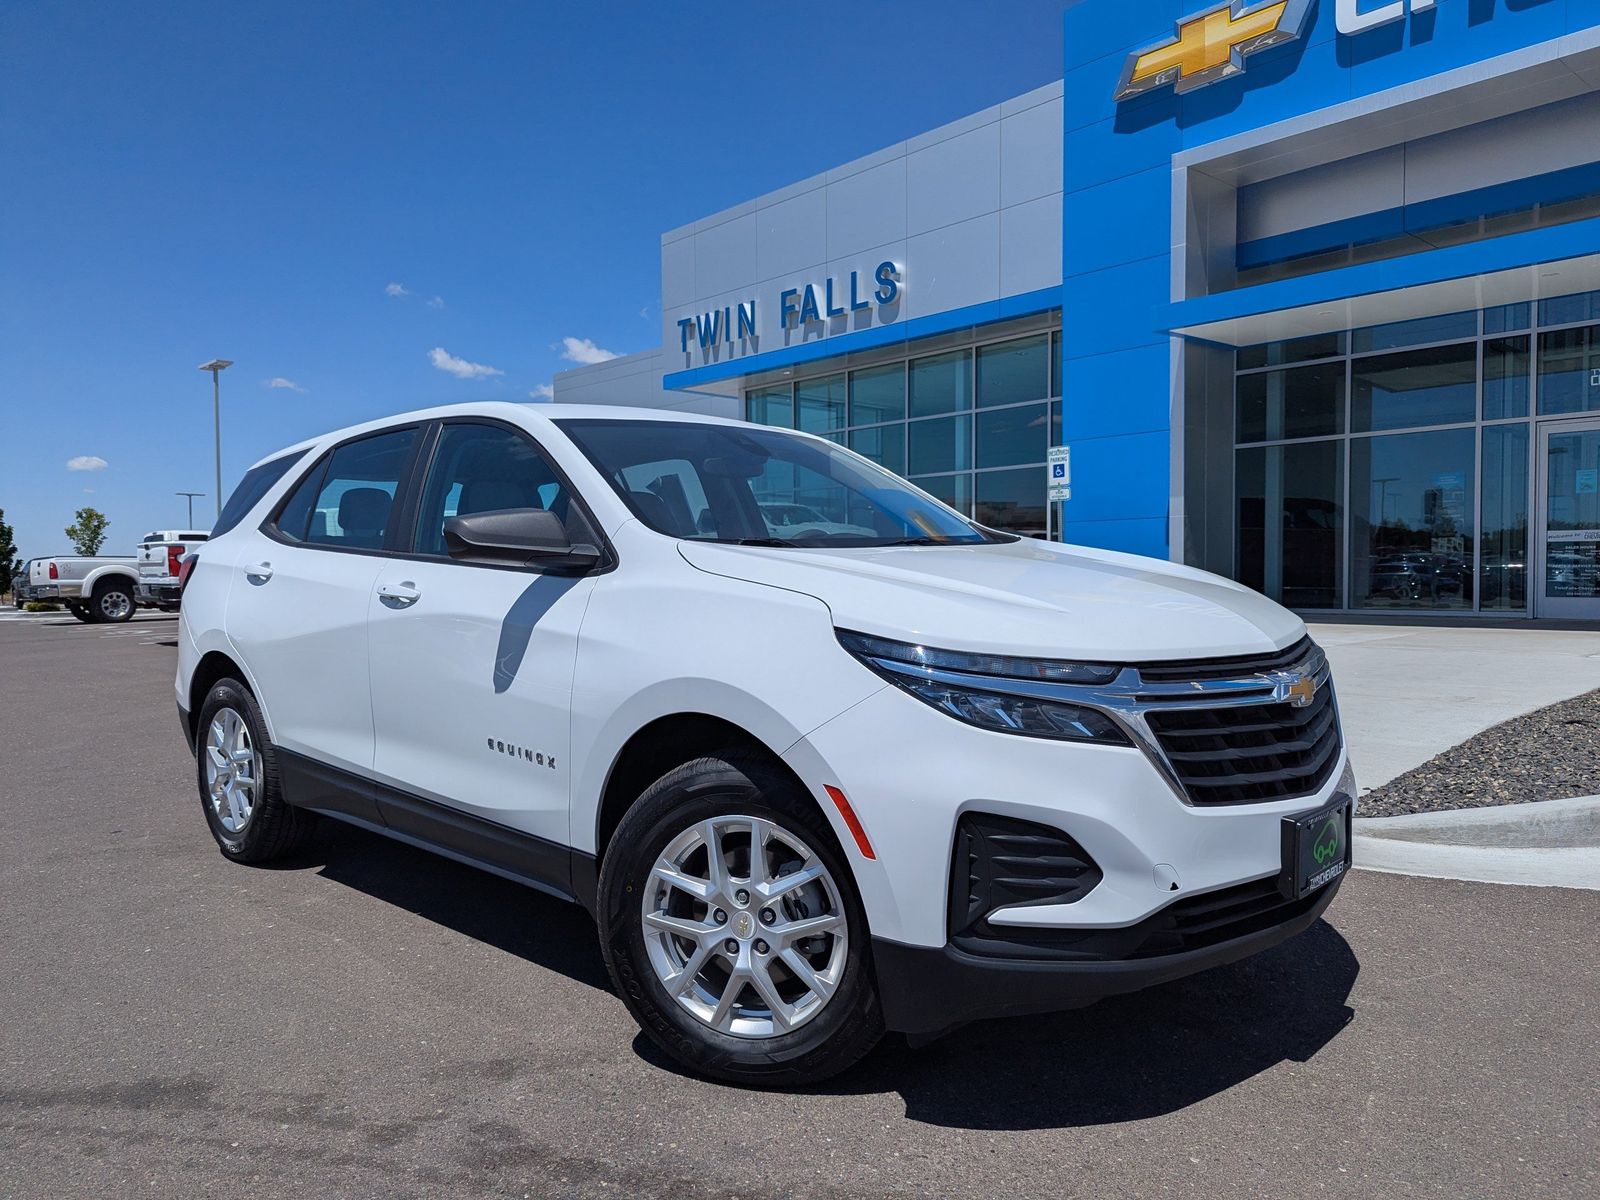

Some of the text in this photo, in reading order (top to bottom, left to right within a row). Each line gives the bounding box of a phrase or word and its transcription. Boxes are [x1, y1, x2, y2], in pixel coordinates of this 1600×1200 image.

[677, 260, 899, 353] TWIN FALLS
[487, 738, 556, 769] EQUINOX
